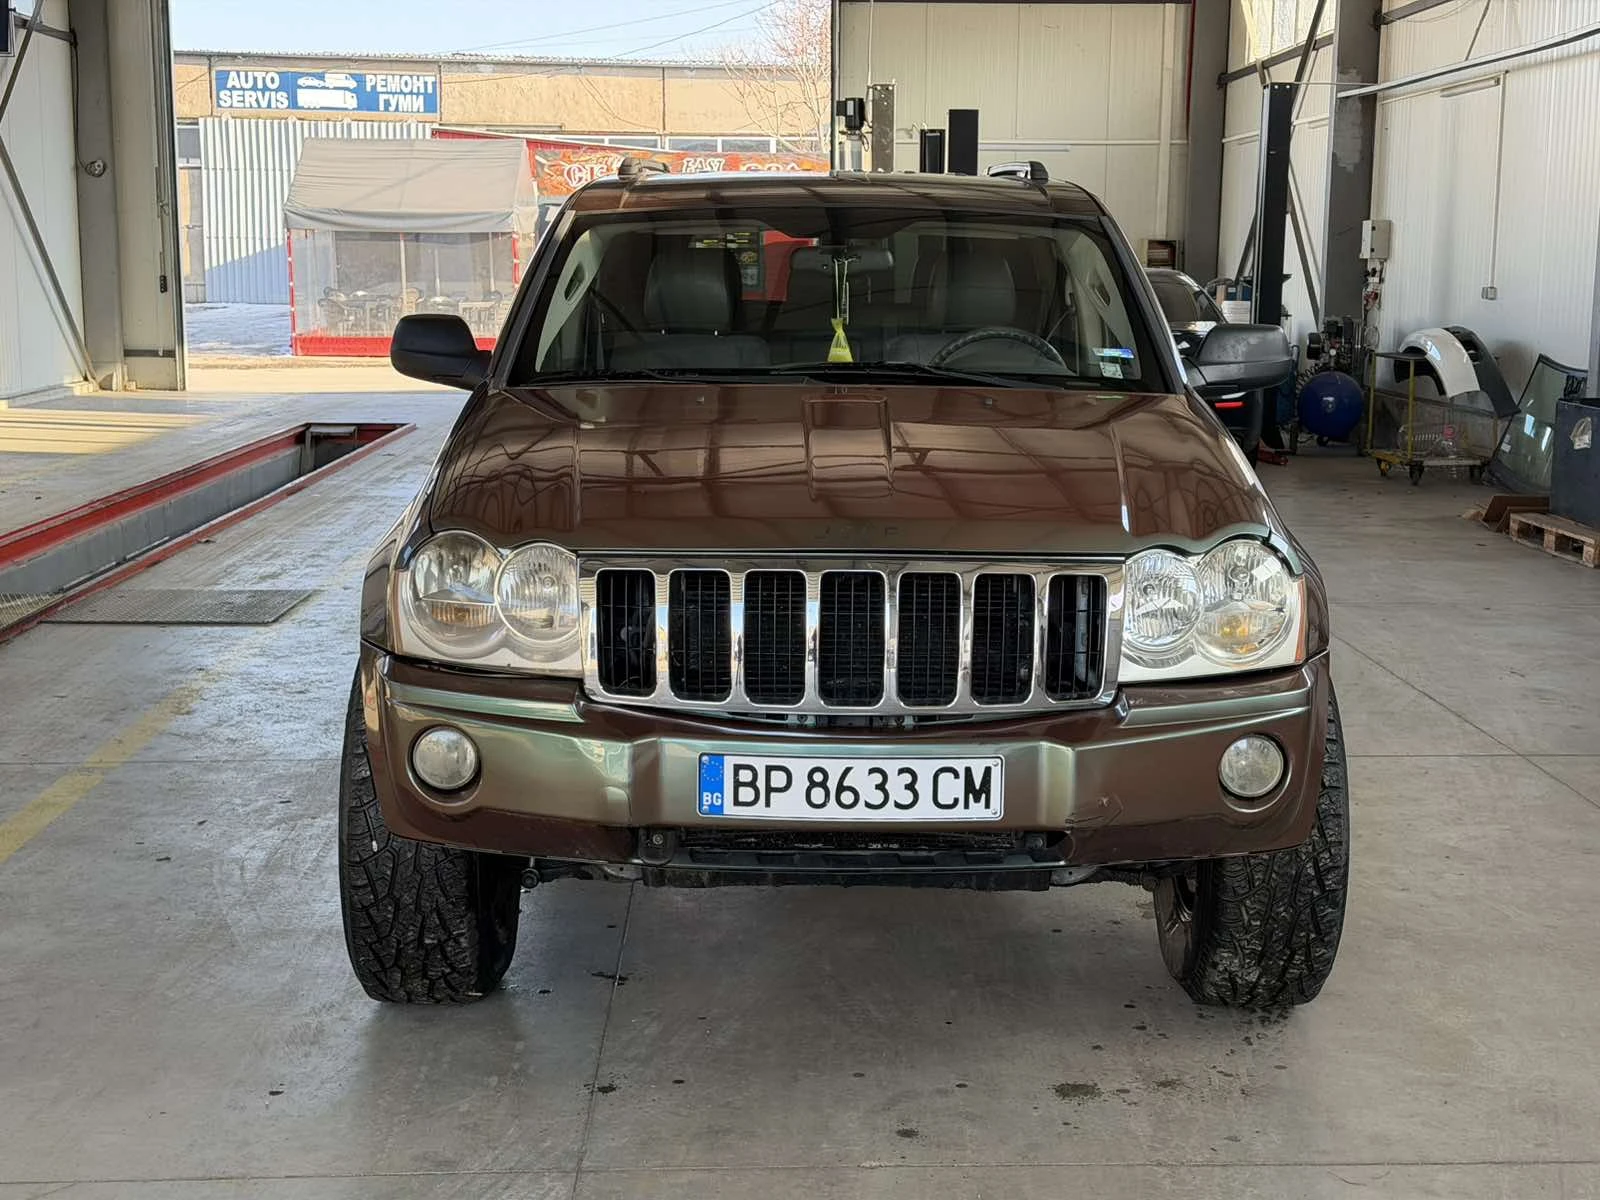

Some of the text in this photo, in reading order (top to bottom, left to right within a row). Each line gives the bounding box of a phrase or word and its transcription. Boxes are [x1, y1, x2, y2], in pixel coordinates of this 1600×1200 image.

[226, 71, 280, 89] AUTO
[365, 74, 436, 94] РЕМОНТ
[219, 90, 289, 109] SERVIS
[378, 94, 425, 113] ГУМИ
[732, 763, 992, 811] BP 8633 CM
[702, 791, 722, 806] BG
